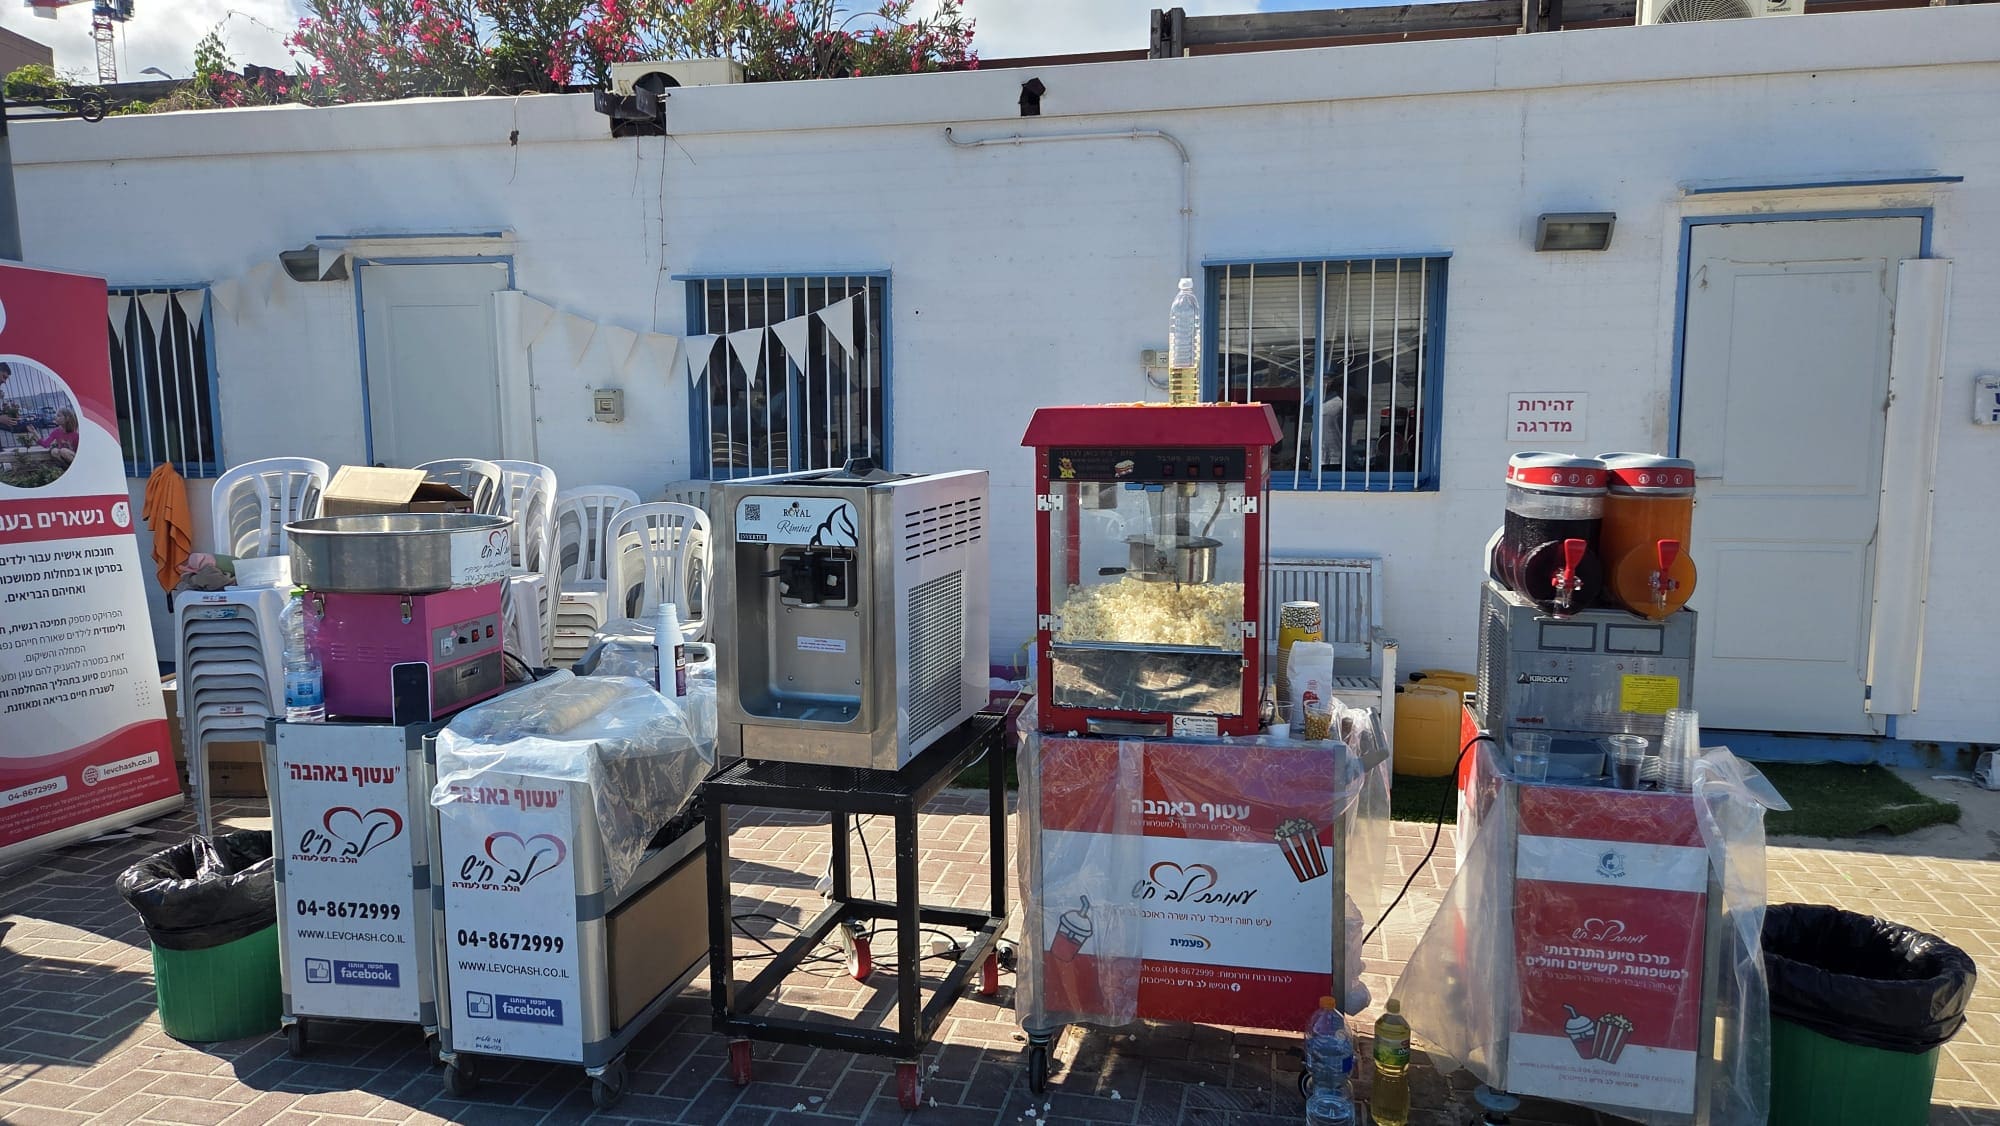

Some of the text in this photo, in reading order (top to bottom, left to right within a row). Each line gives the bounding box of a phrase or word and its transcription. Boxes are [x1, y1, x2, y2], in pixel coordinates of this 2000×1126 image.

[1517, 400, 1574, 411] זהירות
[1517, 421, 1572, 432] מדרגה
[37, 508, 105, 528] נשארים
[783, 507, 811, 518] ROYAL
[29, 553, 51, 563] עבור
[54, 550, 82, 561] אישית
[84, 547, 114, 558] חונכות
[44, 567, 81, 580] במחלות
[82, 566, 92, 576] או
[95, 563, 123, 577] בסרטן
[4, 585, 86, 603] ואחיהם הבריאים.
[68, 615, 91, 626] מספק
[93, 609, 123, 622] הפרויקט
[40, 617, 67, 628] תמיכה
[67, 628, 91, 640] לילדים
[93, 623, 126, 636] ולימודית
[15, 637, 38, 648] חייהם
[40, 632, 65, 644] שאורח
[23, 644, 86, 663] המחלה והשיקום.
[110, 653, 125, 663] זאת
[53, 660, 81, 674] להעניק
[82, 655, 109, 667] במטרה
[18, 669, 33, 681] עוגן
[35, 665, 51, 676] להם
[82, 672, 99, 682] סיוע
[11, 681, 48, 696] ההחלמה
[50, 676, 80, 690] בתהליך
[89, 683, 115, 696] לשגרת
[43, 692, 69, 706] בריאה
[70, 689, 87, 700] חיים
[103, 756, 153, 776] levchash.co.il
[8, 782, 58, 801] 04-8672999
[1131, 799, 1250, 822] עטוף באהבה
[1193, 888, 1258, 907] עמותת
[296, 899, 401, 920] 04-8672999
[1168, 911, 1188, 921] ושרה
[297, 929, 406, 944] WWW.LEVCHASH.CO.IL
[457, 929, 564, 954] 04-8672999
[1170, 936, 1204, 948] פעמית
[1525, 955, 1564, 968] וחולים
[1544, 945, 1670, 965] מרכז סיוע התנדבותי
[341, 967, 392, 980] facebook
[458, 961, 570, 979] WWW.LEVCHASH.CO.IL
[1168, 967, 1214, 977] 04-8672999
[1567, 960, 1618, 975] קשישים
[502, 1002, 555, 1017] facebook
